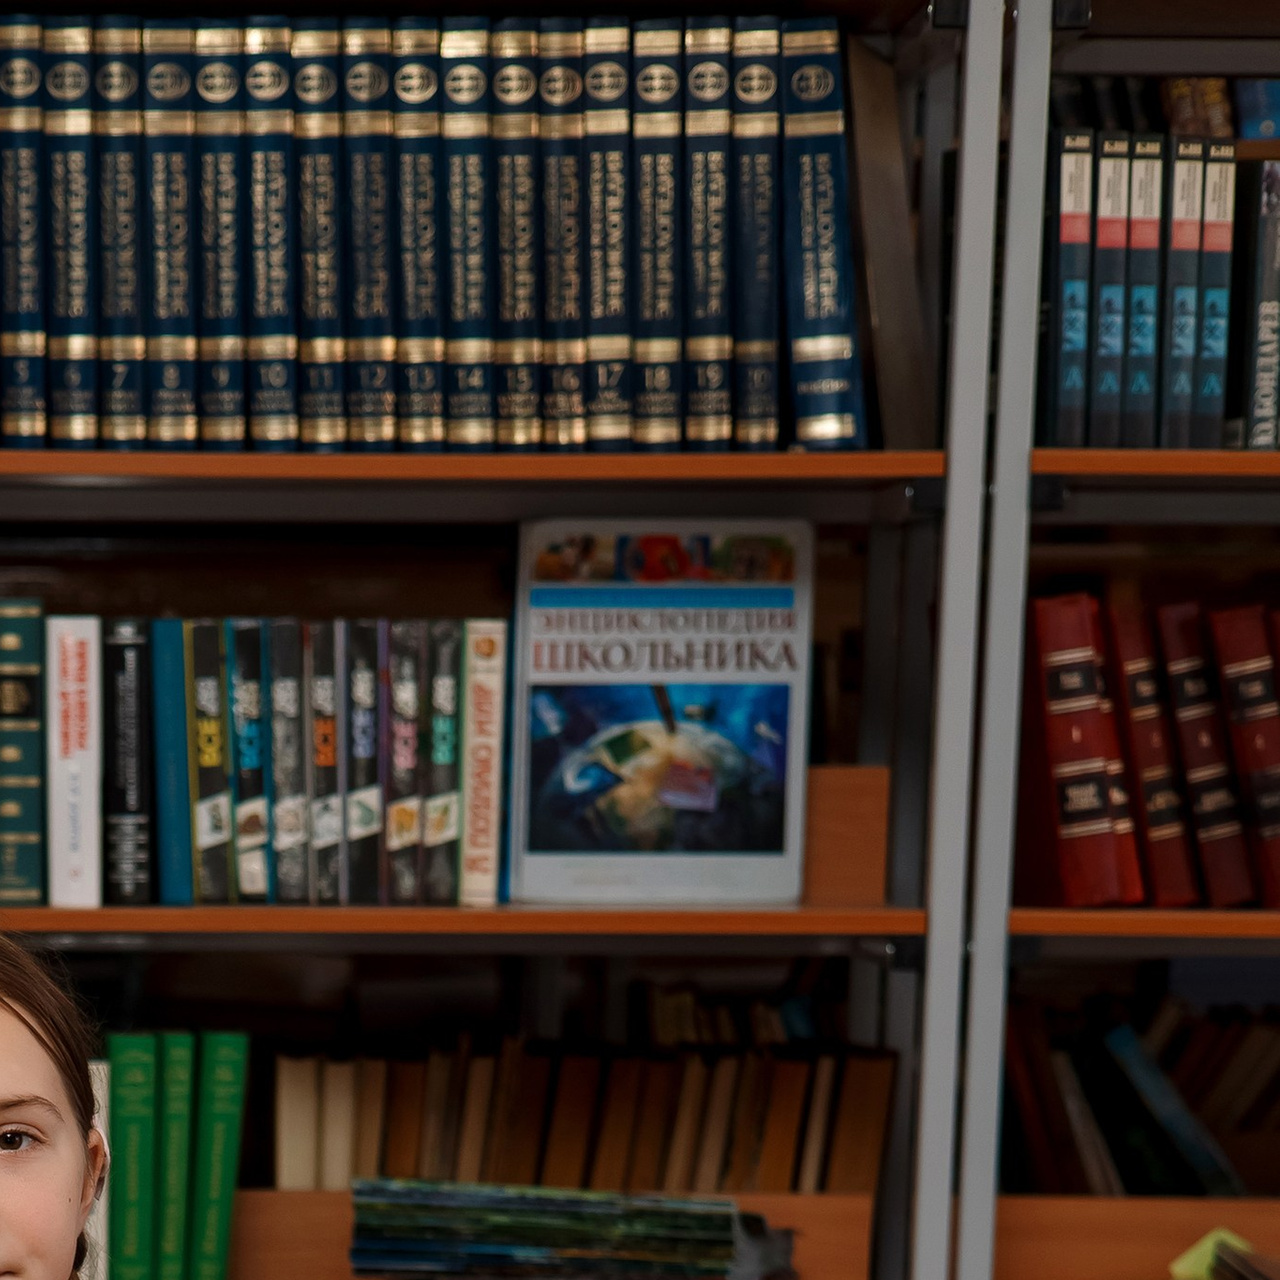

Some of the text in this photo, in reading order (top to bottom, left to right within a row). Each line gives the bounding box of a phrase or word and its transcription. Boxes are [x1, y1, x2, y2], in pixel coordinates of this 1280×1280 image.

[111, 363, 128, 387] 7
[161, 363, 180, 389] 8
[259, 361, 288, 389] 10
[358, 364, 389, 389] 12
[457, 364, 484, 390] 14
[551, 365, 580, 390] 16
[596, 362, 621, 387] 17
[643, 364, 672, 390] 18
[696, 363, 722, 388] 19
[539, 608, 798, 635] ЭНЦИКЛОПЕДИЯ
[532, 638, 799, 673] ШКОЛЬНИКА
